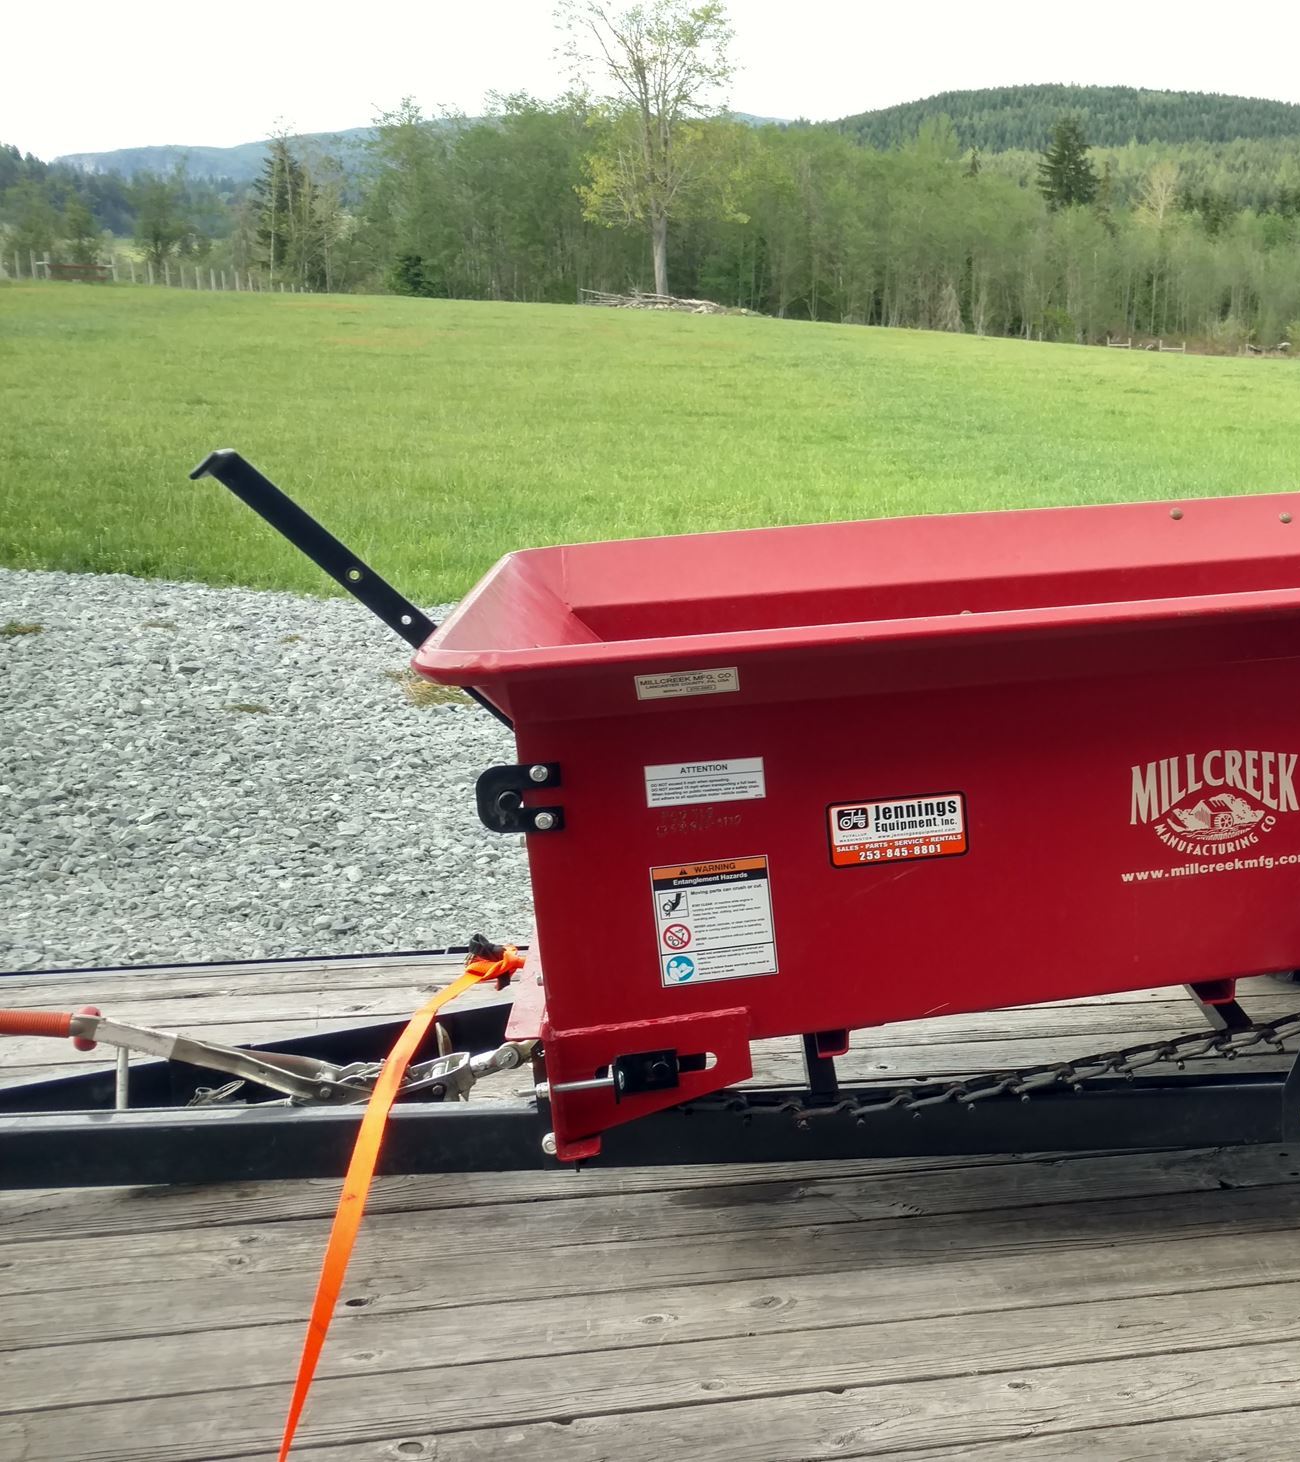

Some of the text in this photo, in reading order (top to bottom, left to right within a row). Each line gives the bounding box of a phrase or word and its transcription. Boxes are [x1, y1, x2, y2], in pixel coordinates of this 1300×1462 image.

[640, 676, 691, 686] MILLCREEK
[680, 764, 728, 774] ATTENTION
[1130, 750, 1300, 825] MILLCREEK
[874, 800, 957, 821] Jennings
[941, 818, 957, 826] Inc.
[836, 845, 859, 853] SALES
[894, 838, 923, 846] SERVICE
[930, 834, 962, 842] RENTALS
[1154, 815, 1276, 856] MANUFACTURING CO
[860, 843, 941, 861] 253-845-8801
[694, 862, 736, 873] WARNING
[673, 872, 748, 886] Entanglement Hazards
